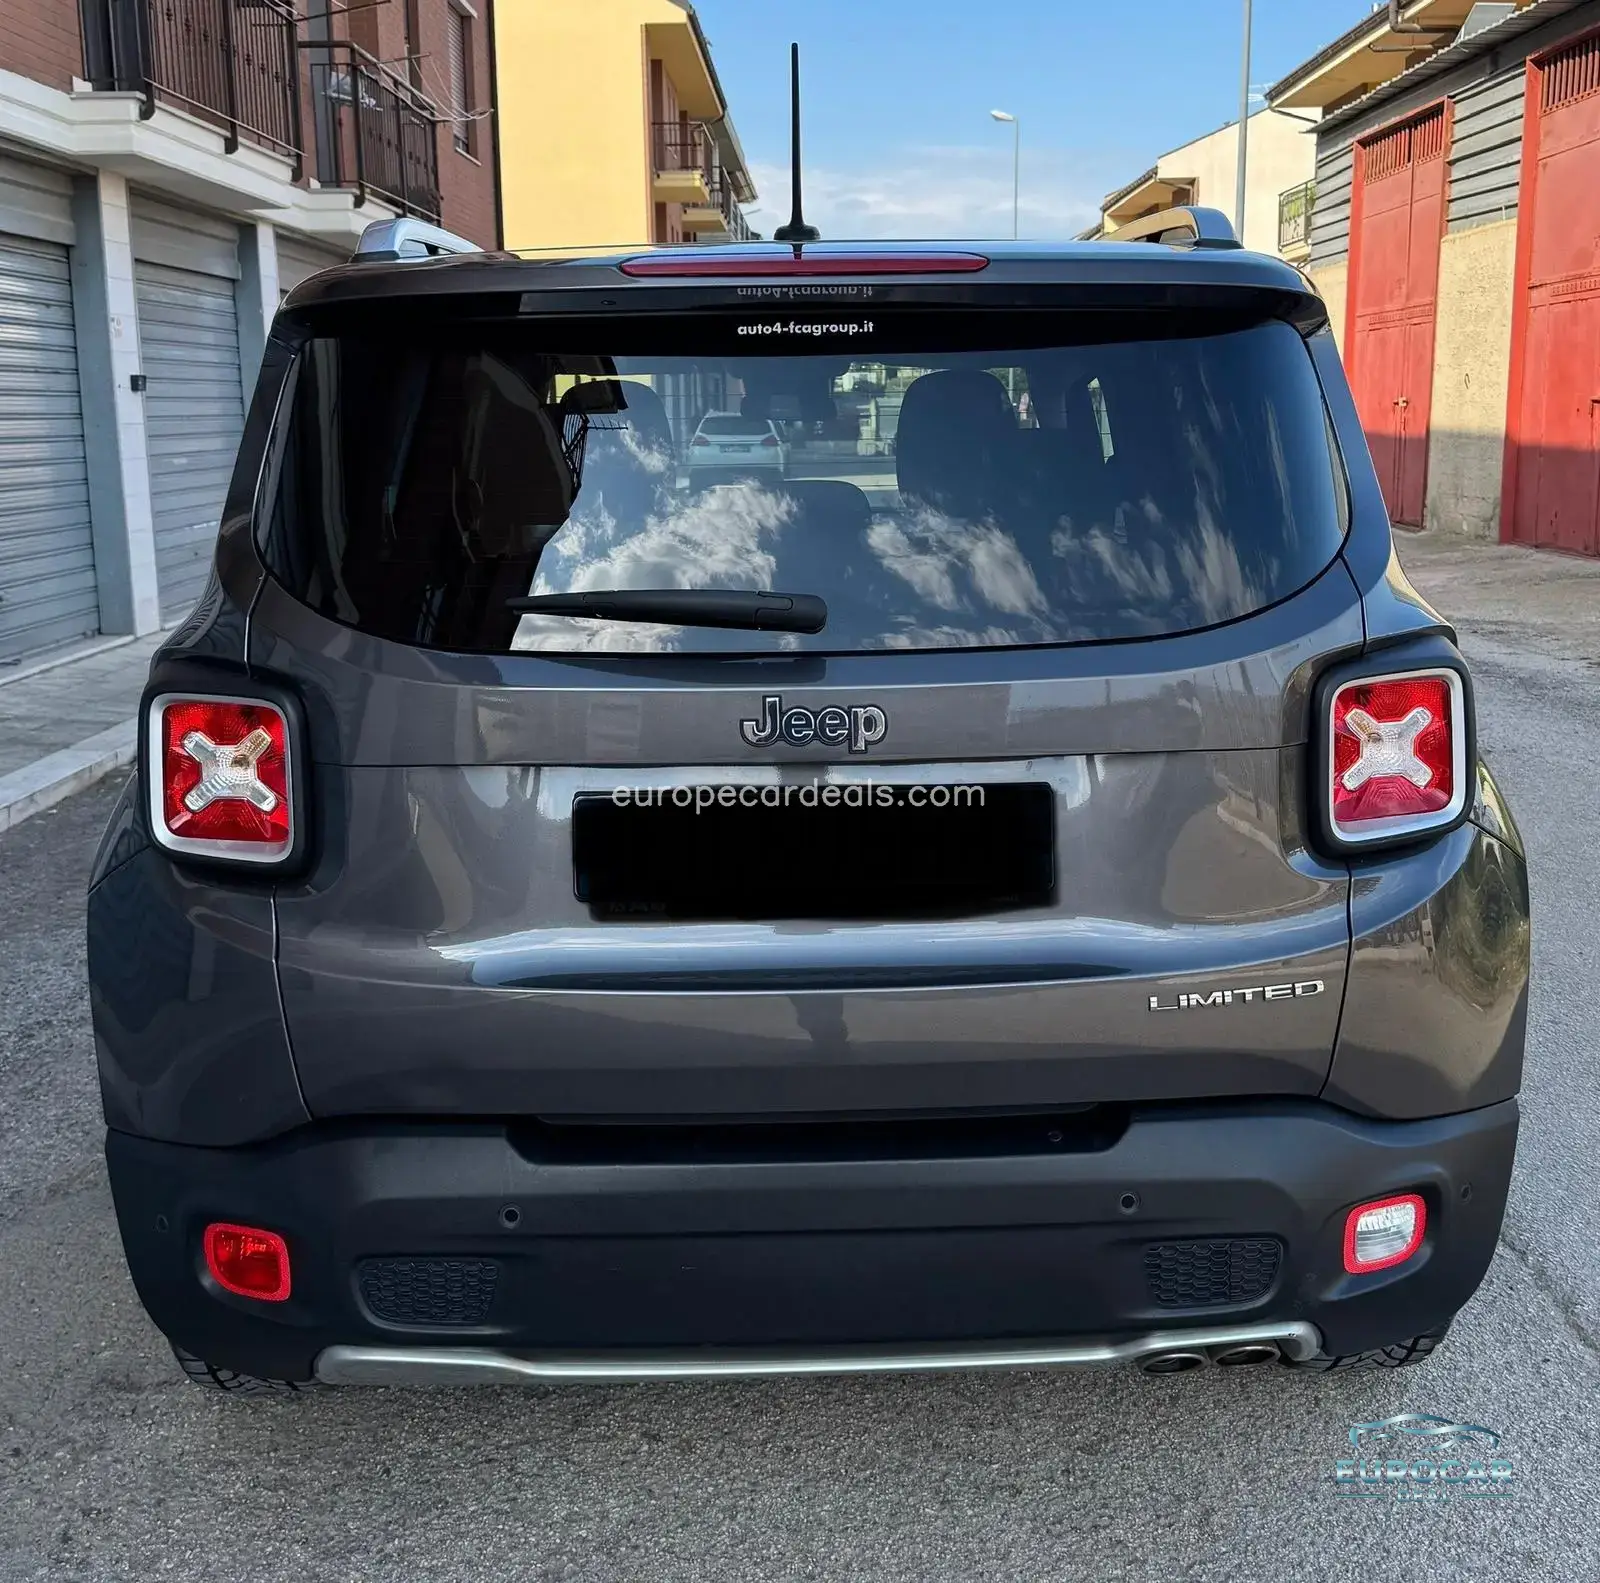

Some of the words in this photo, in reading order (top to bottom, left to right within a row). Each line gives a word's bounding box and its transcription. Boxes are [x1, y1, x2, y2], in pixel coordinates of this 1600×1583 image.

[737, 320, 873, 336] auto4-fcagroup.it
[740, 695, 888, 754] Jeep
[1148, 979, 1325, 1012] LIMITED
